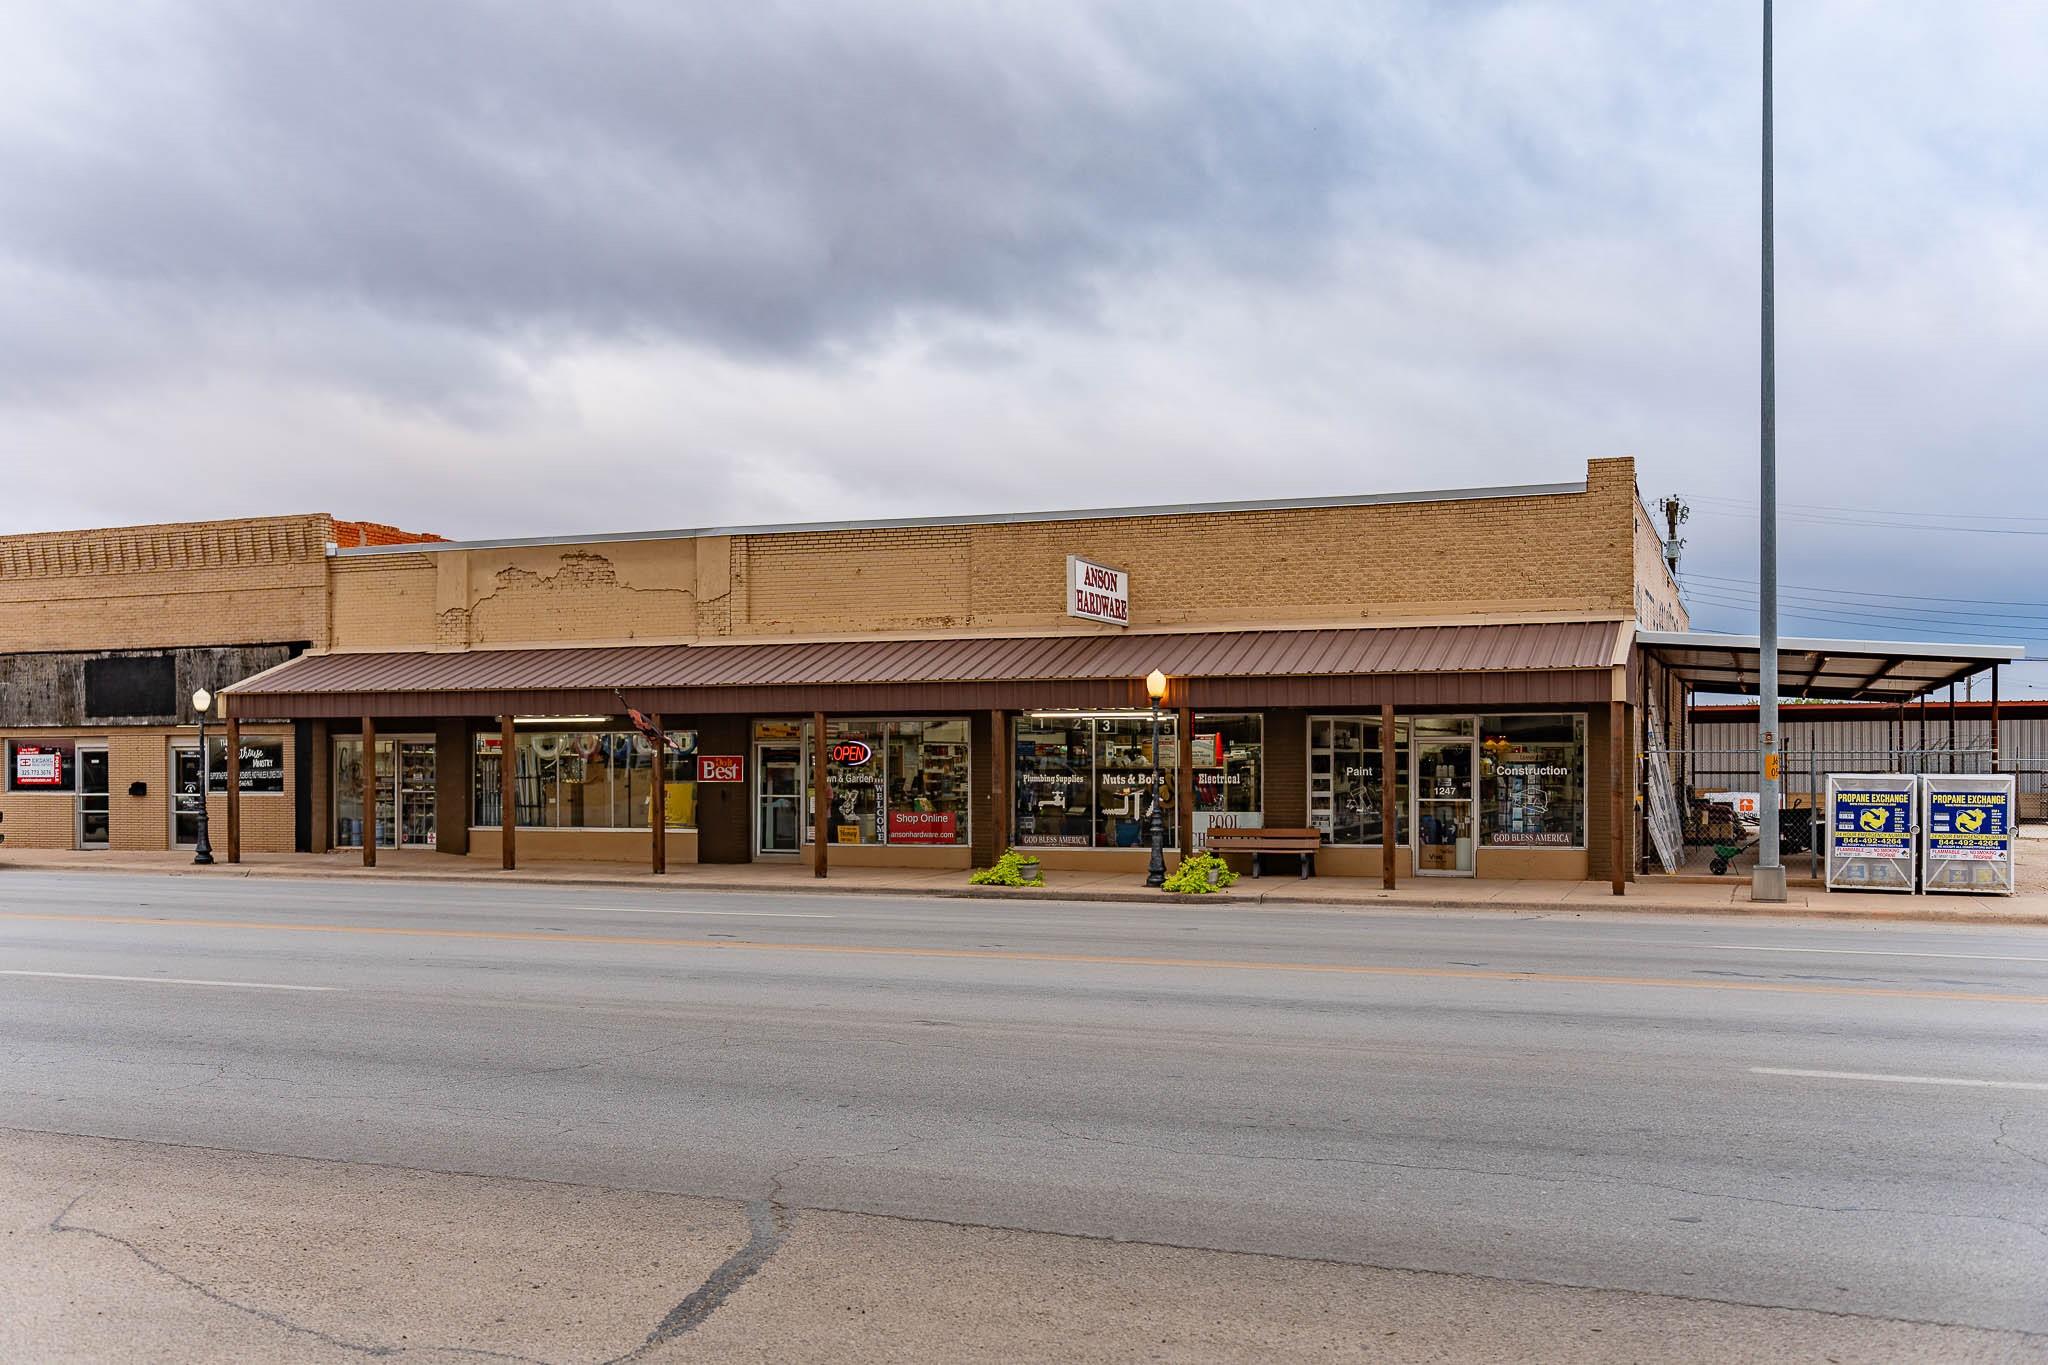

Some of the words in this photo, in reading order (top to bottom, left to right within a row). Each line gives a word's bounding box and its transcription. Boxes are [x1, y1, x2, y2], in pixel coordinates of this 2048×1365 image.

[1084, 565, 1117, 592] ANSON
[1076, 589, 1127, 620] HARDWARE
[1102, 720, 1111, 732] 3
[1163, 723, 1171, 734] 5
[834, 746, 865, 761] OPEN
[252, 759, 273, 769] MINISTRY
[703, 760, 739, 780] Best
[1346, 767, 1373, 777] Paint
[1496, 765, 1568, 776] Construction
[838, 774, 844, 783] &
[1023, 774, 1055, 785] Plumbing
[1055, 774, 1084, 785] Supplies
[1102, 773, 1126, 785] Nuts
[1127, 774, 1136, 785] &
[1138, 773, 1165, 785] Bols
[1198, 773, 1241, 785] Electrical
[1434, 787, 1457, 796] 1247
[1837, 793, 1870, 803] PROPANE
[1871, 793, 1909, 803] EXCHANGE
[1932, 794, 1966, 804] PROPANE
[1967, 794, 2006, 805] EXCHANGE
[875, 784, 884, 841] WELCOME
[896, 813, 919, 824] Shop
[920, 813, 949, 823] Online
[1024, 835, 1038, 844] GOD
[1038, 835, 1057, 844] BLESS
[1058, 835, 1087, 845] AMERICA
[1493, 833, 1510, 843] GOD
[1511, 833, 1534, 843] BLESS
[1535, 833, 1570, 844] AMERICA
